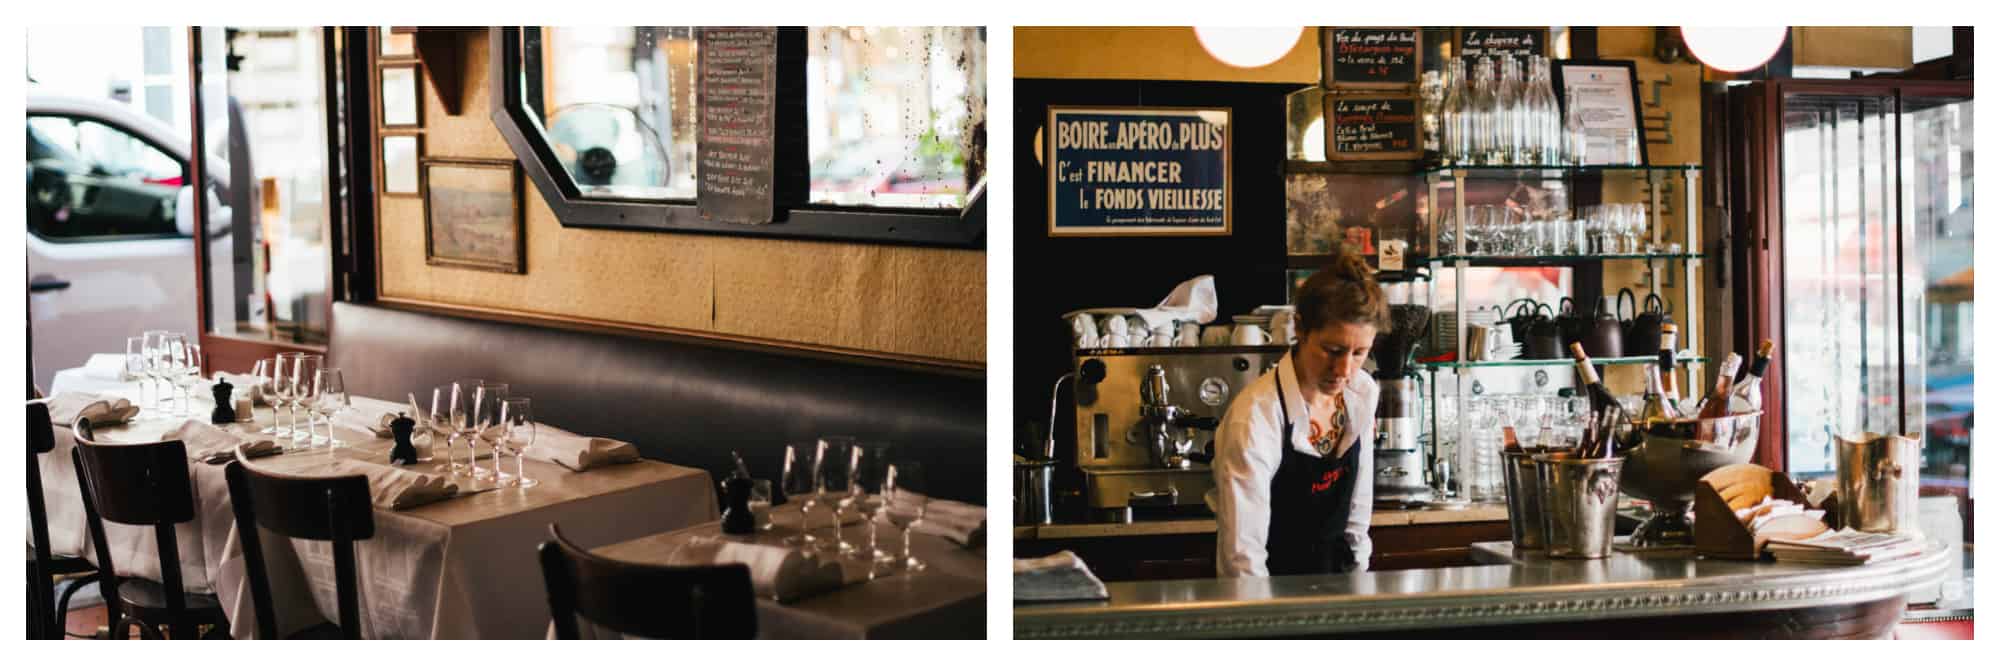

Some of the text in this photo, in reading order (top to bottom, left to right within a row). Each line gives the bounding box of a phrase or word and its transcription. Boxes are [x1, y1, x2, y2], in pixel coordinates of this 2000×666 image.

[1058, 121, 1109, 150] BOIRE
[1117, 119, 1173, 151] APÉRO
[1180, 121, 1223, 151] PLUS
[1058, 160, 1182, 183] C'est FINANCER
[1095, 188, 1144, 210] FONDS
[1148, 188, 1223, 210] VIEILLESSE
